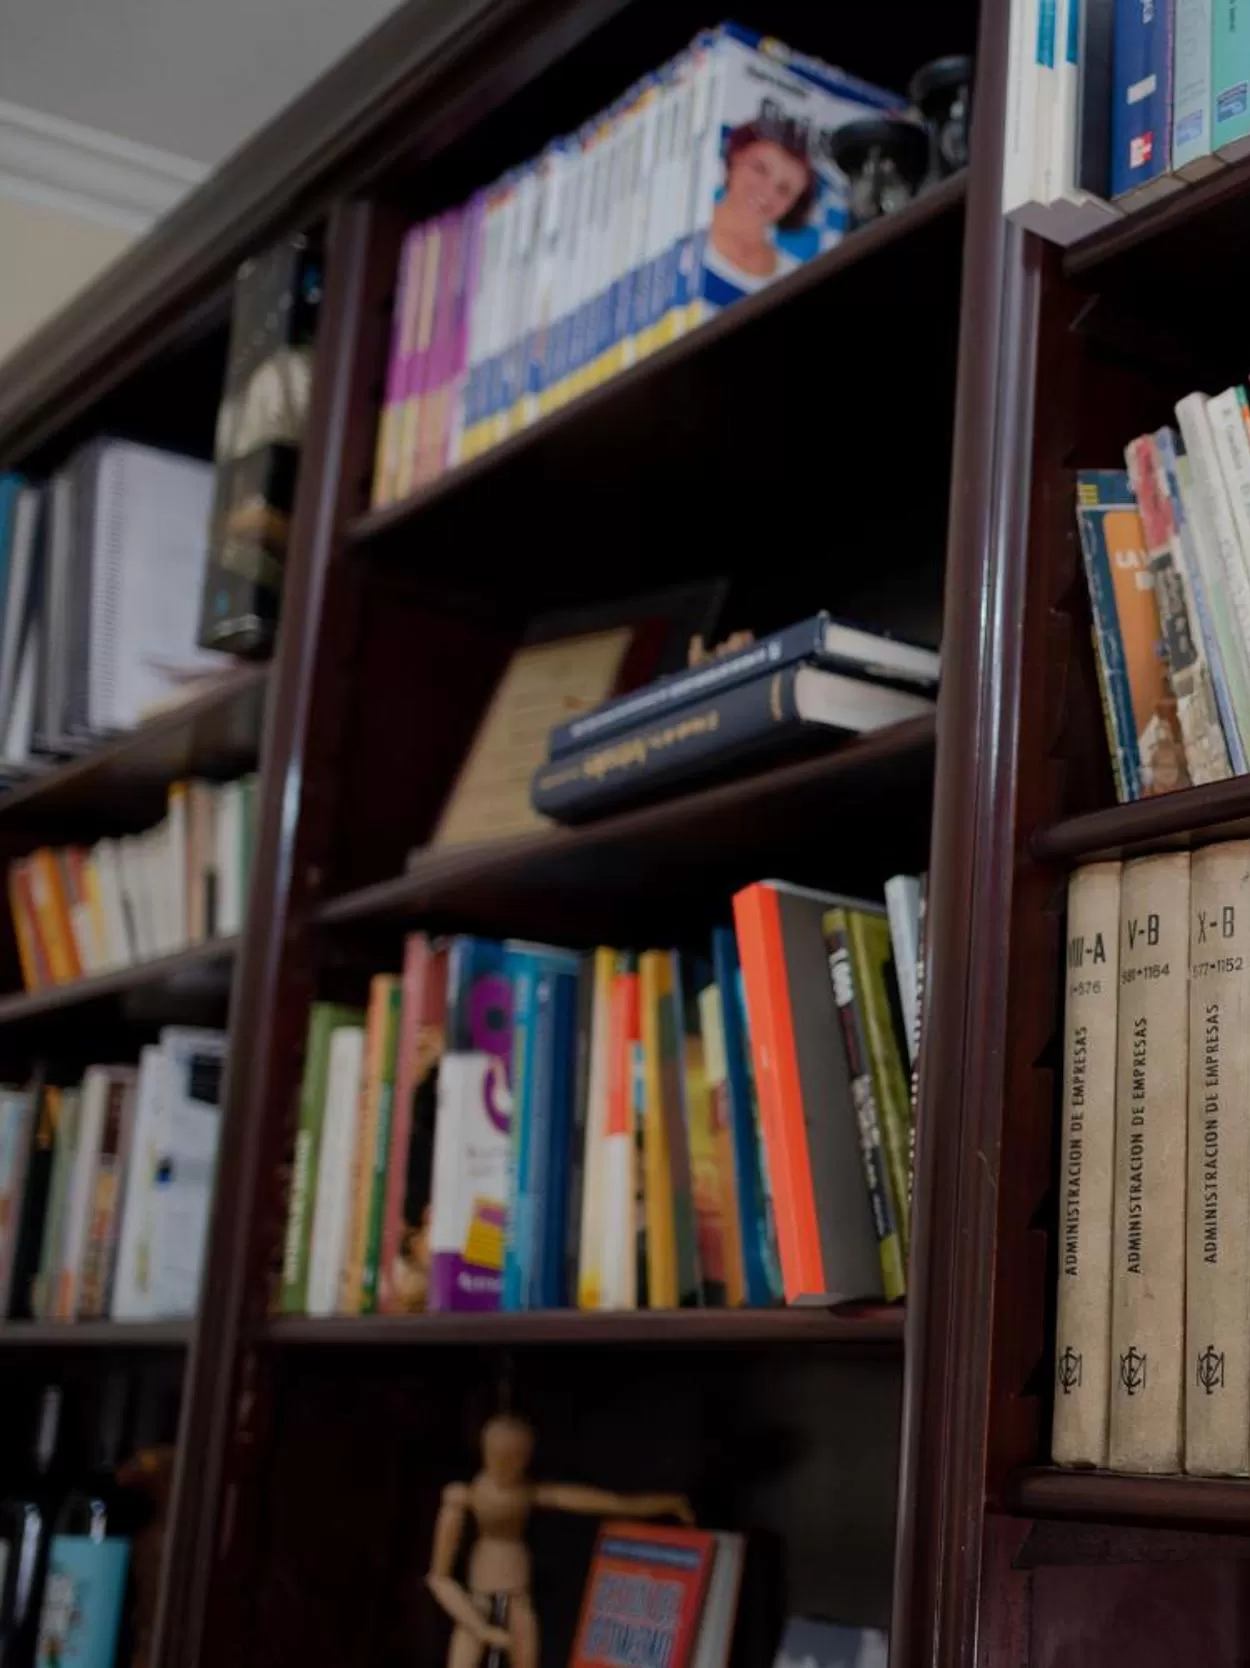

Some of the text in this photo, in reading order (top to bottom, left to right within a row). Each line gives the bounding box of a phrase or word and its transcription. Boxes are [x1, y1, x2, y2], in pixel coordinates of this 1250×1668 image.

[1128, 914, 1160, 950] V-B
[1198, 906, 1234, 944] X-B
[1064, 1026, 1088, 1277] ADMINISTRACION DE EMPRESAS
[1128, 1016, 1148, 1274] ADMINISTRACION DE EMPRESAS
[1204, 1003, 1219, 1265] ADMINISTRACION DE EMPRESAS
